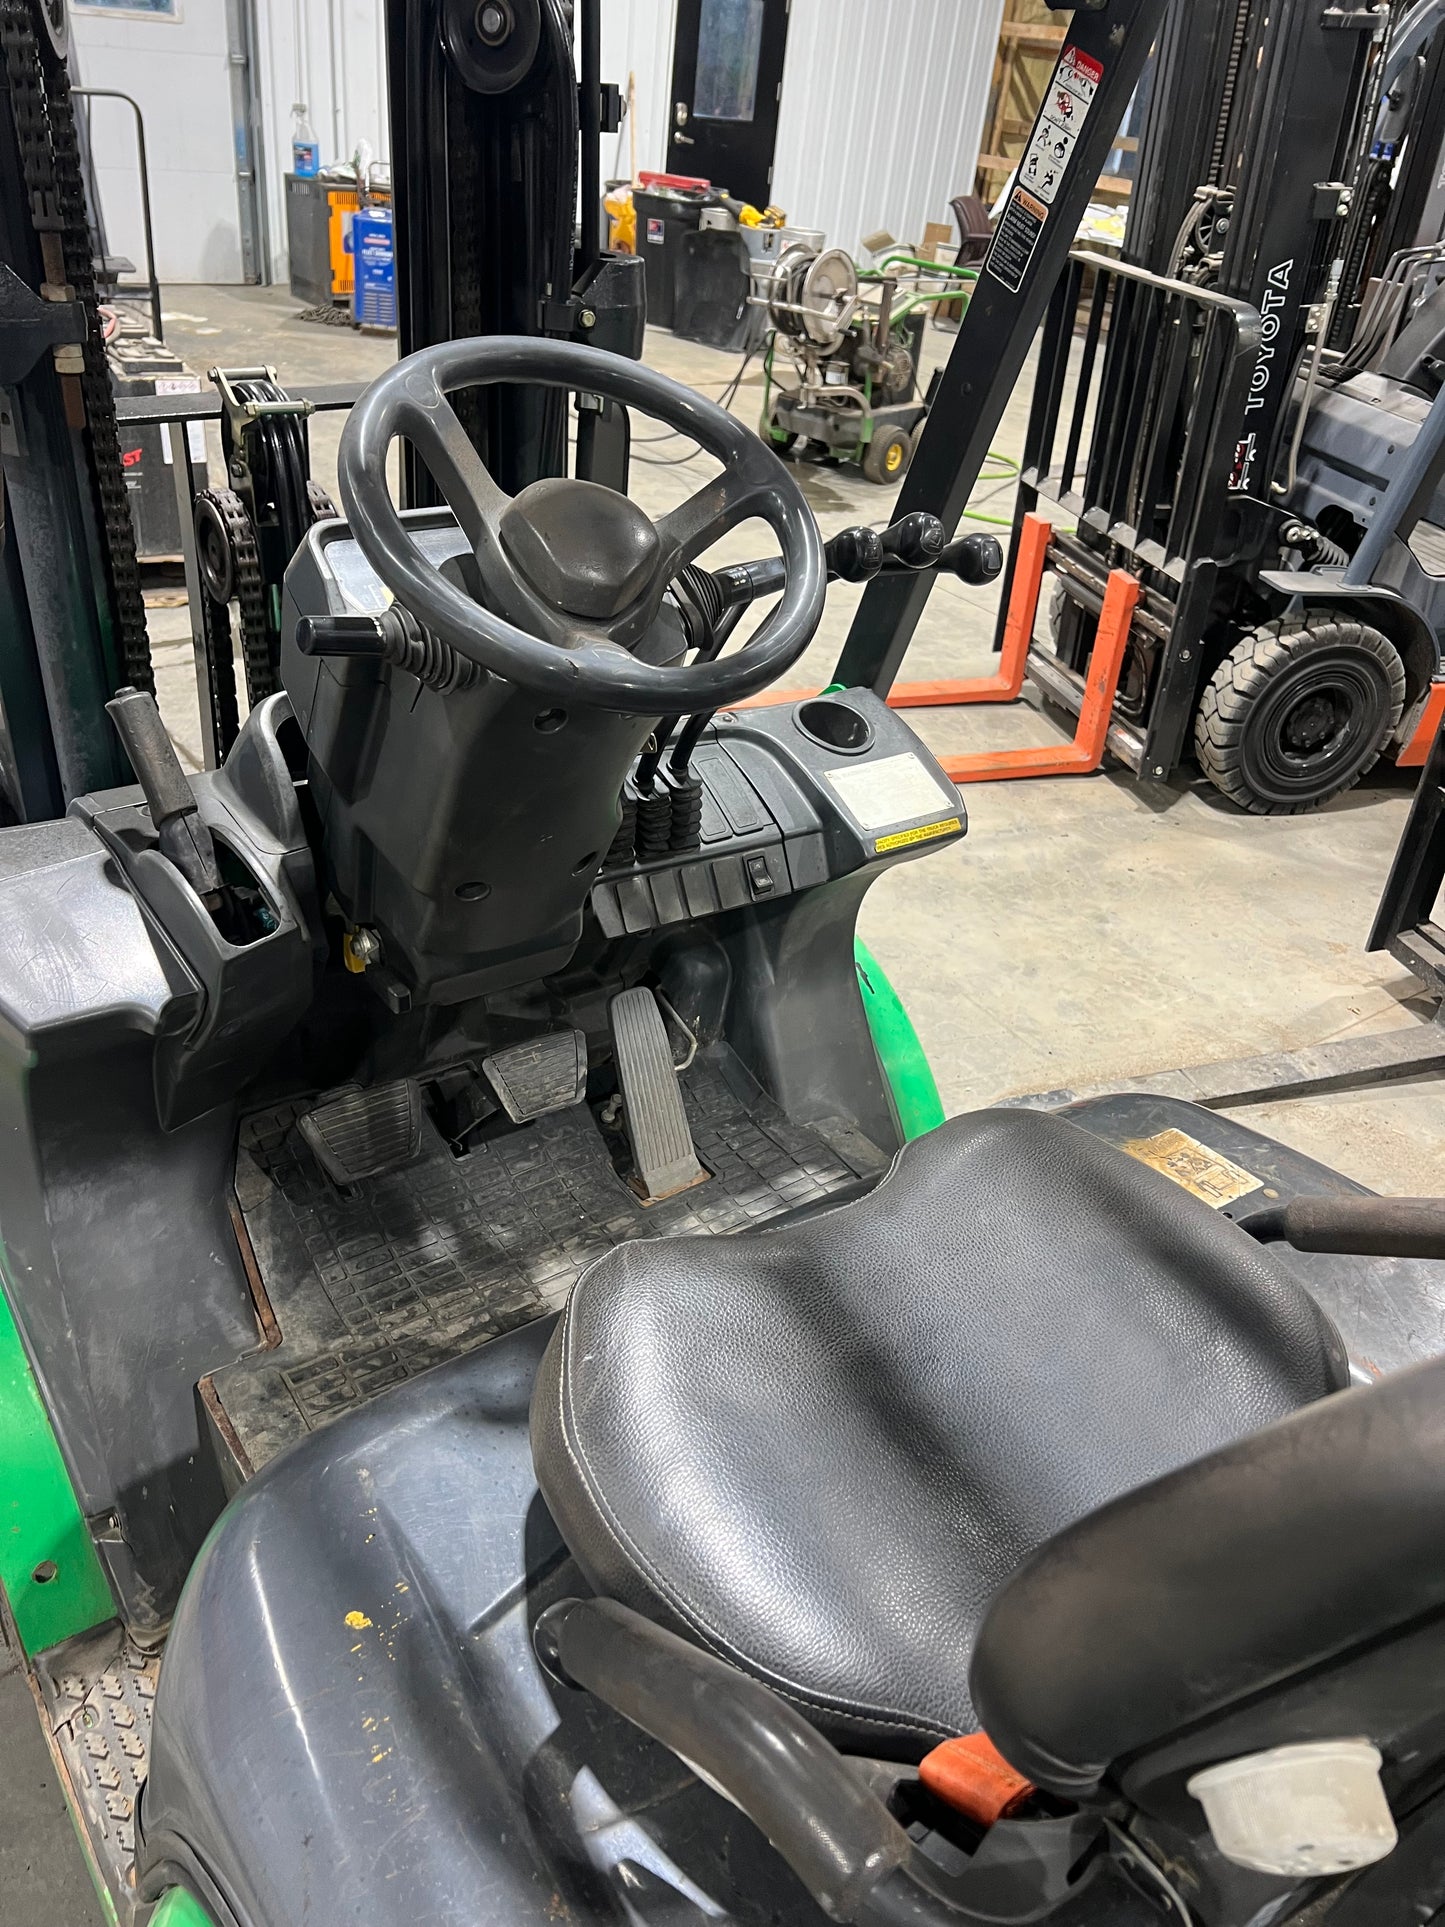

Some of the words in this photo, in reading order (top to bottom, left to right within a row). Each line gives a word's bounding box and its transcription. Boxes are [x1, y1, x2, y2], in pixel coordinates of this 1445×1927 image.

[1076, 60, 1100, 81] DANGER
[1023, 198, 1045, 219] WARNING
[1244, 258, 1294, 416] TOYOTA
